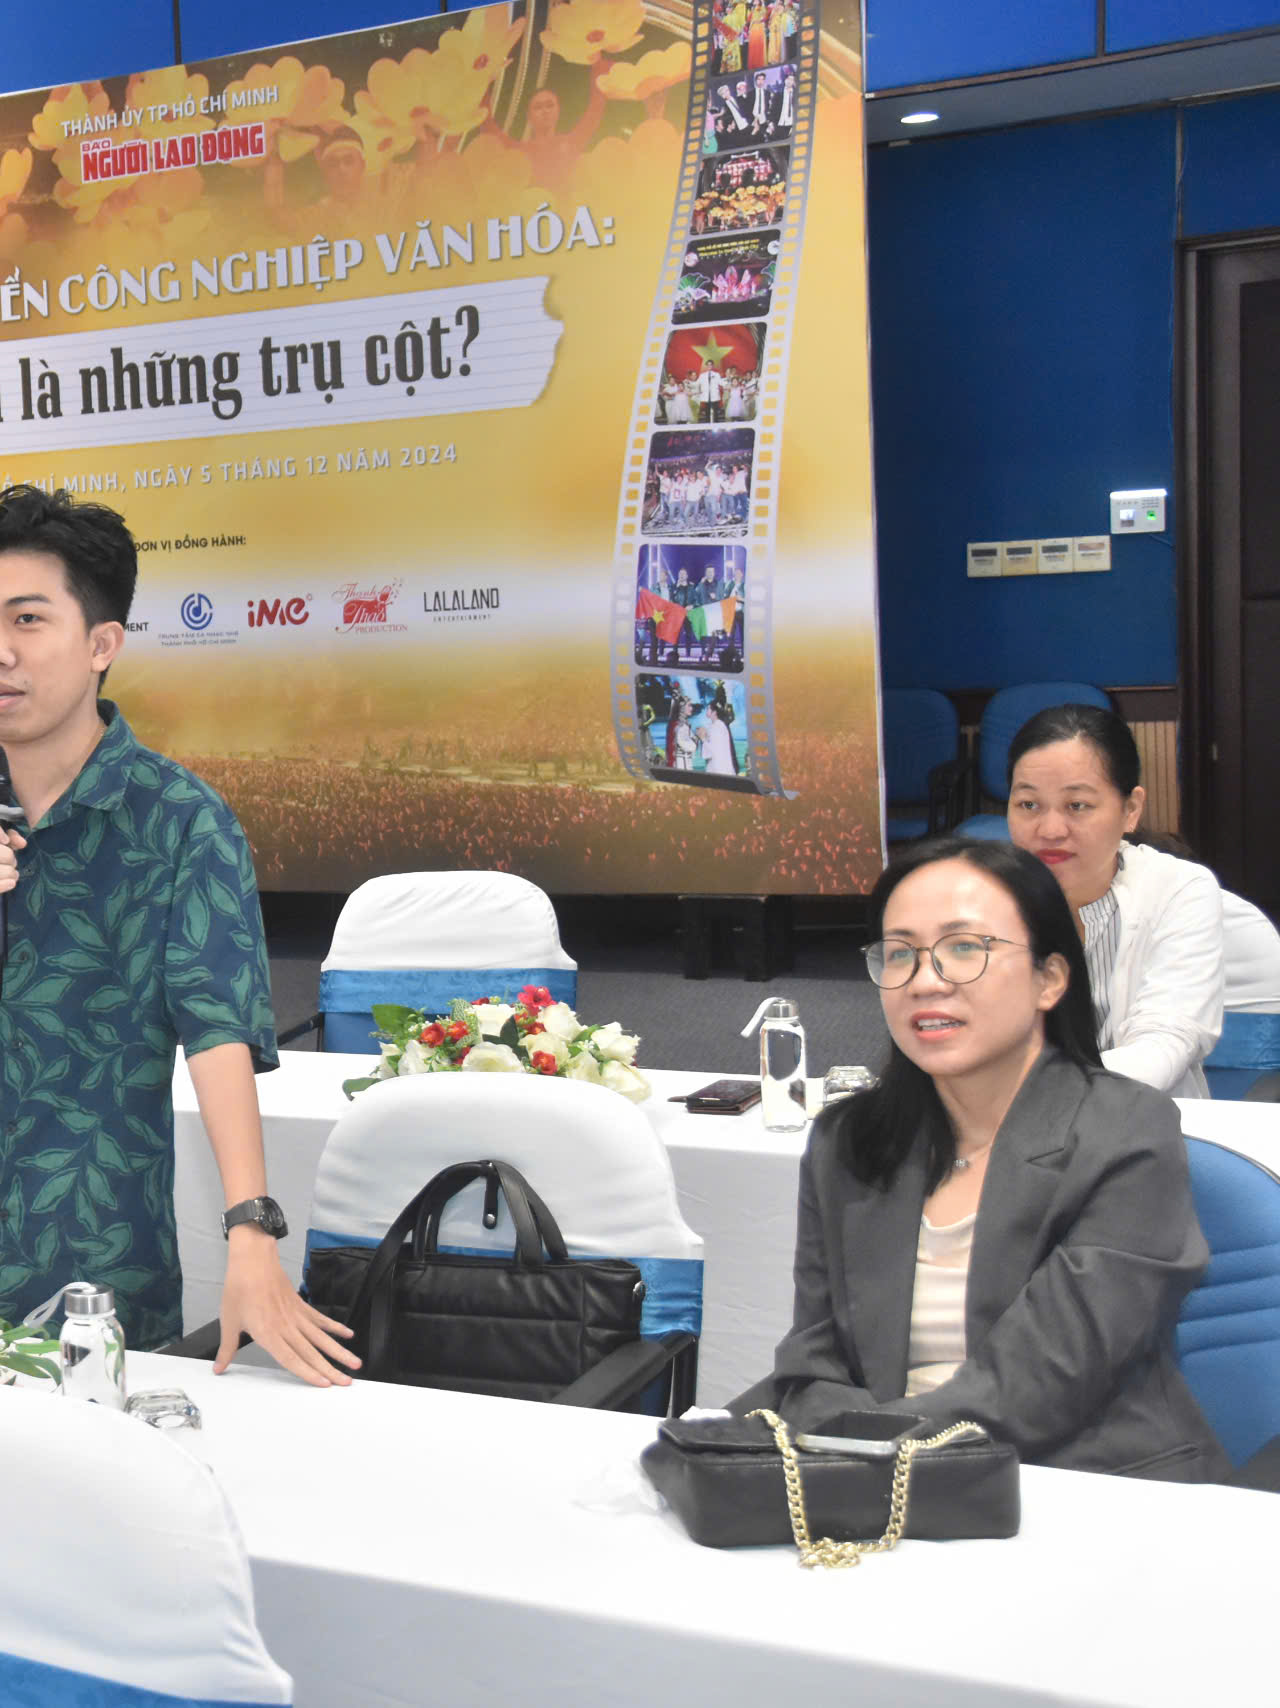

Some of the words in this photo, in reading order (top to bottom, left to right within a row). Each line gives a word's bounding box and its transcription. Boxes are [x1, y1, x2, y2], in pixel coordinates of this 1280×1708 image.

[61, 112, 118, 137] THÀNH
[122, 105, 144, 128] ỦY
[148, 104, 168, 122] TP
[172, 95, 196, 119] HỒ
[200, 90, 227, 114] CHÍ
[232, 86, 279, 107] MINH
[82, 142, 149, 182] NGƯỜI
[153, 135, 196, 171] LAO
[200, 125, 265, 163] ĐỘNG
[58, 261, 181, 314] CÔNG
[191, 233, 364, 299] NGHIỆP
[375, 218, 474, 274] VĂN
[487, 201, 615, 260] HÓA:
[19, 357, 63, 420] là
[79, 347, 243, 420] những
[259, 336, 344, 404] trụ
[365, 305, 479, 397] cột?
[64, 472, 127, 495] MINH,
[135, 464, 192, 489] NGÀY
[200, 465, 212, 483] 5
[220, 456, 297, 481] THÁNG
[305, 455, 328, 475] 12
[336, 447, 391, 472] NĂM
[400, 443, 457, 467] 2024
[160, 540, 172, 553] VỊ
[175, 533, 208, 549] ĐỒNG
[211, 533, 247, 547] HÀNH:
[423, 587, 500, 612] LALALAND
[355, 624, 408, 633] PRODUCTION
